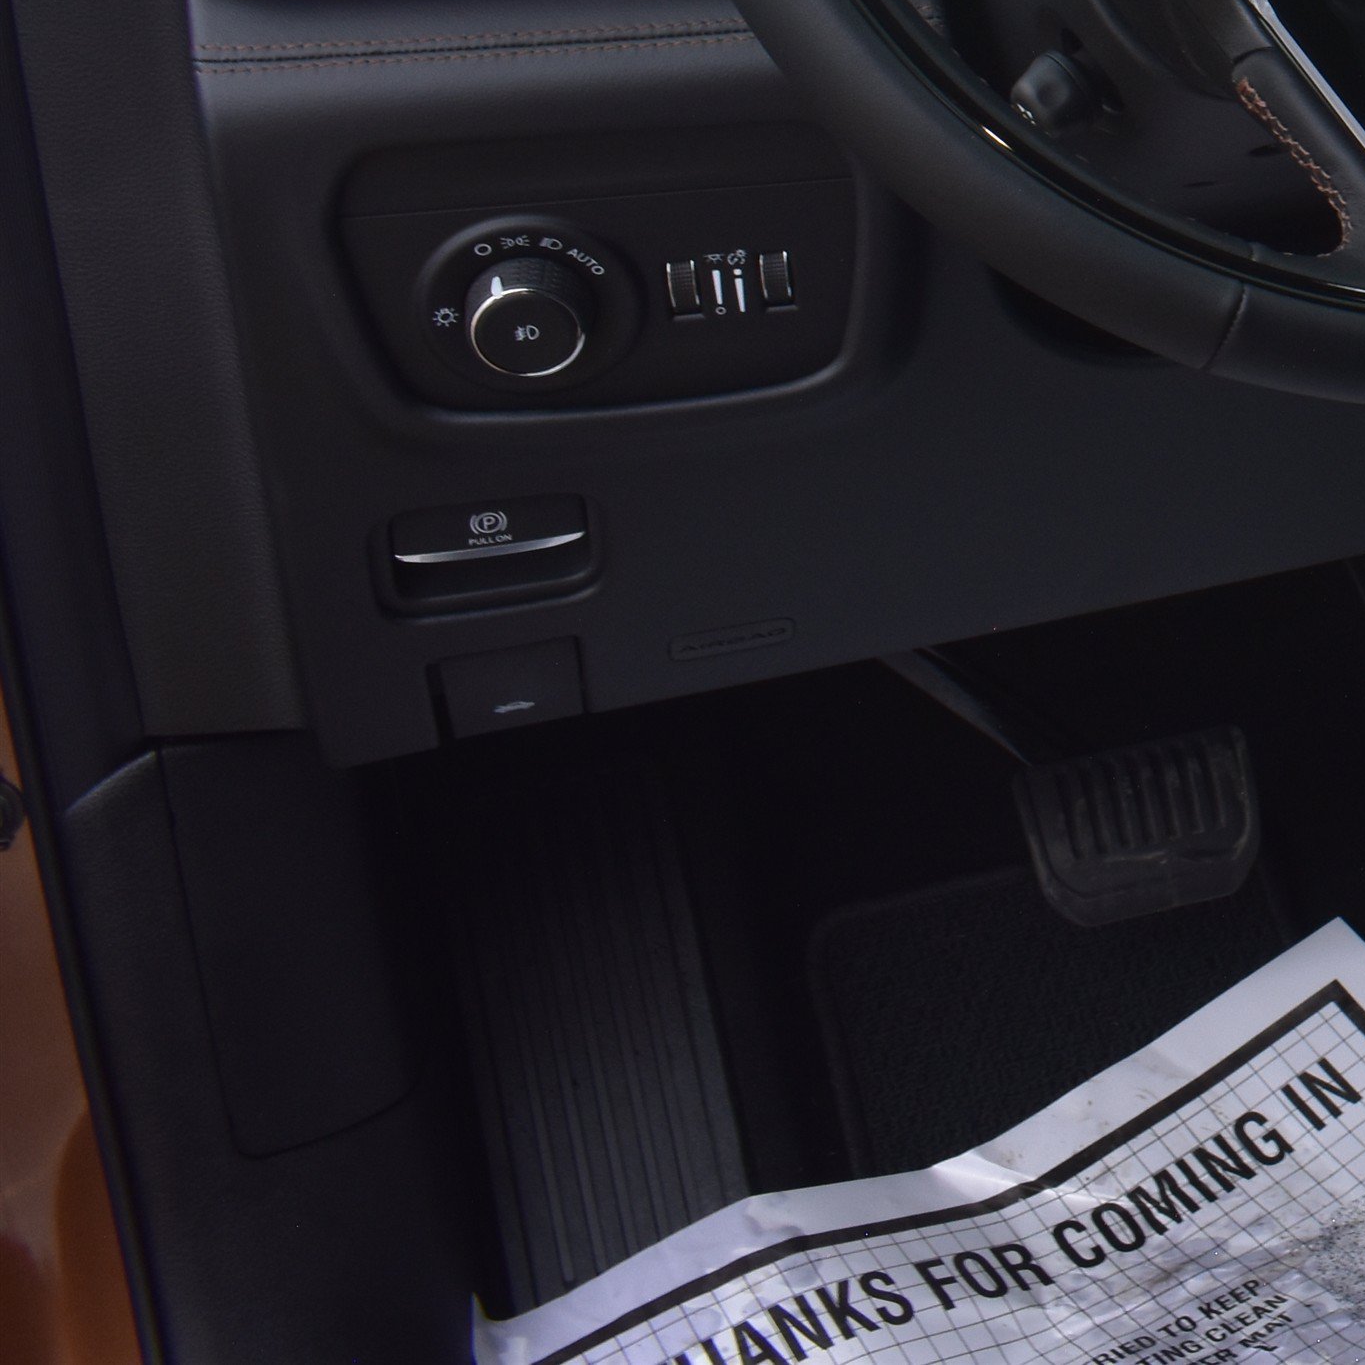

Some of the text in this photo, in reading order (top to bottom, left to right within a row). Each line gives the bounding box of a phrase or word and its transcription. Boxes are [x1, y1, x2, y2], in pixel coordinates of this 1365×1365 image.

[566, 248, 605, 276] AUTO
[468, 534, 513, 546] PULL ON
[657, 1057, 1364, 1365] ANKS FOR COMING IN
[1083, 1279, 1260, 1365] RIED TO KEEP
[1189, 1311, 1294, 1365] ER MAT
[1206, 1294, 1289, 1344] CLEAN
